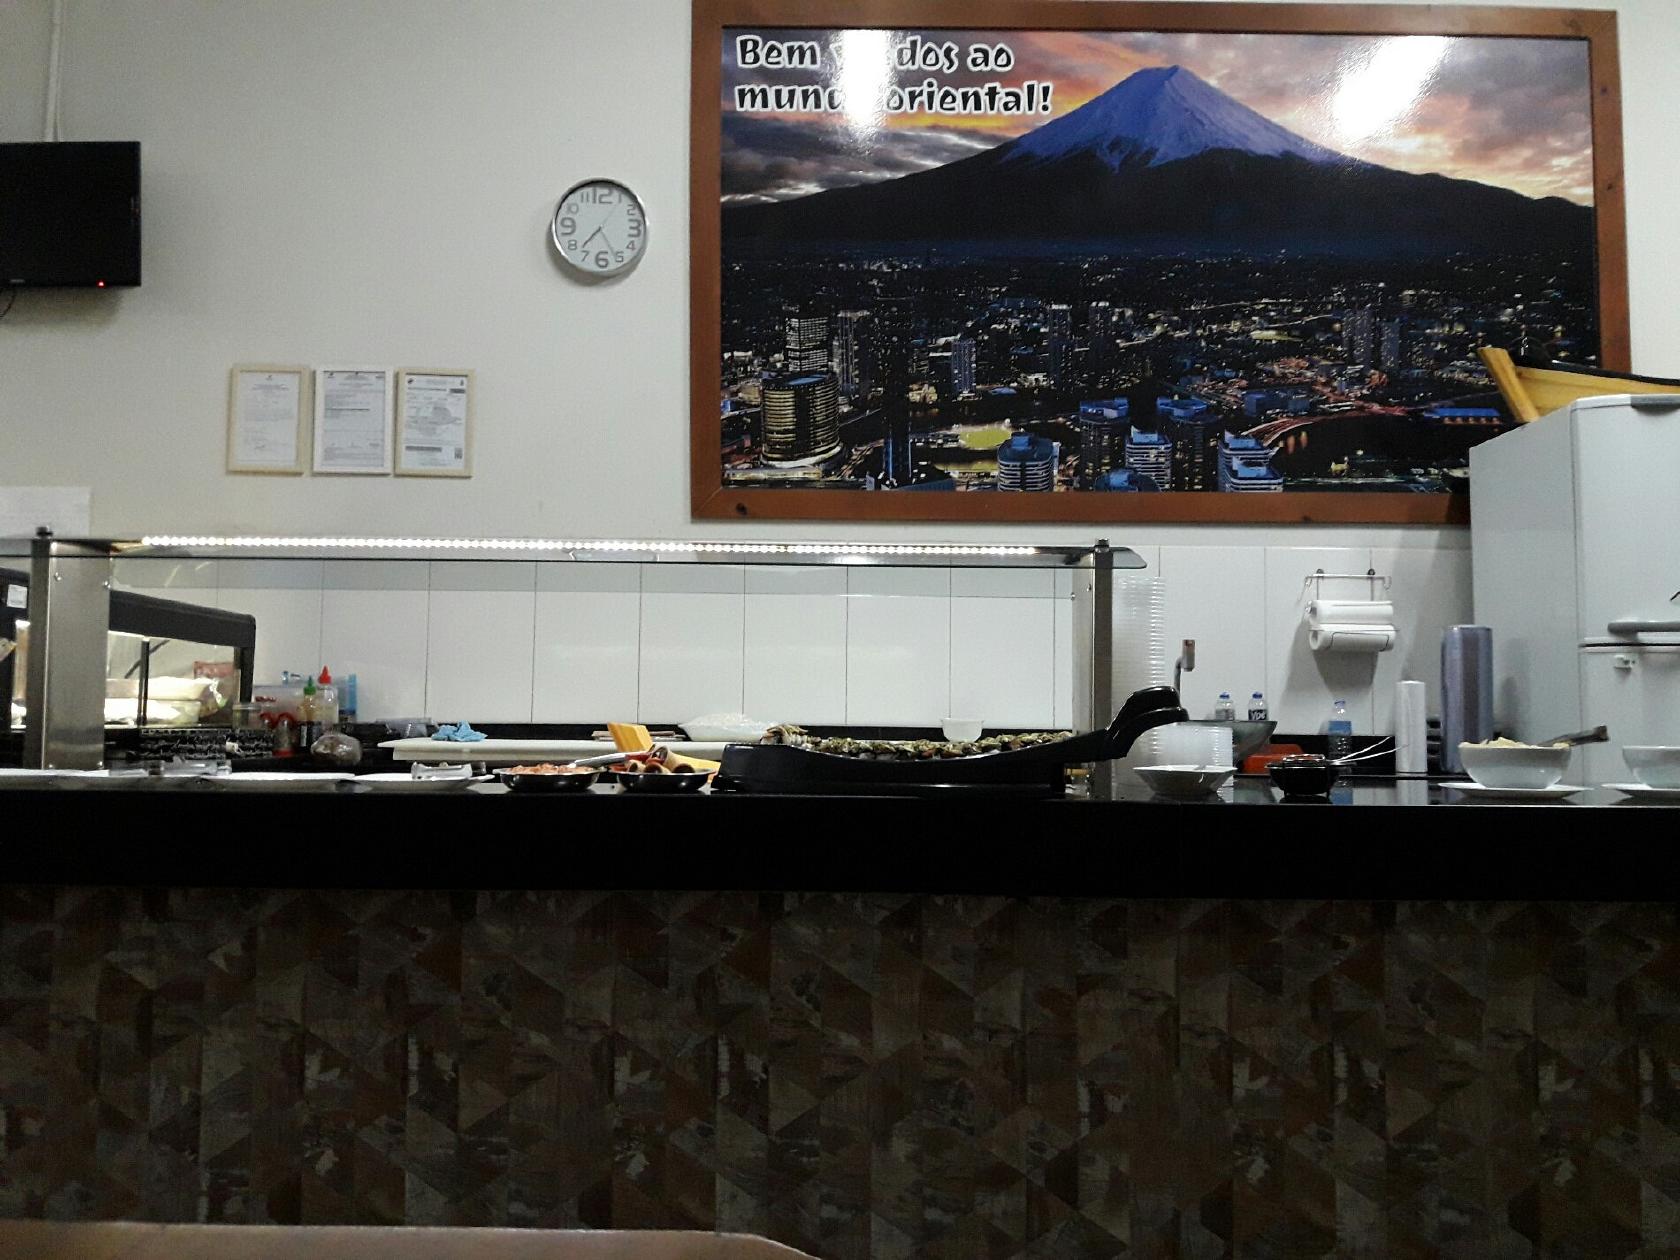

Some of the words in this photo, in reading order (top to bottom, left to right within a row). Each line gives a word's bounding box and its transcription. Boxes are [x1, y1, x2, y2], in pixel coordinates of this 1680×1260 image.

[737, 36, 820, 69] Bem
[968, 43, 1014, 70] ao
[886, 80, 1053, 115] oriental!
[592, 187, 613, 204] 12
[626, 203, 636, 216] 2
[560, 217, 576, 236] 9
[628, 218, 641, 238] 3
[567, 239, 578, 251] 8
[626, 240, 636, 251] 4
[581, 250, 589, 261] 7
[595, 250, 609, 268] 6
